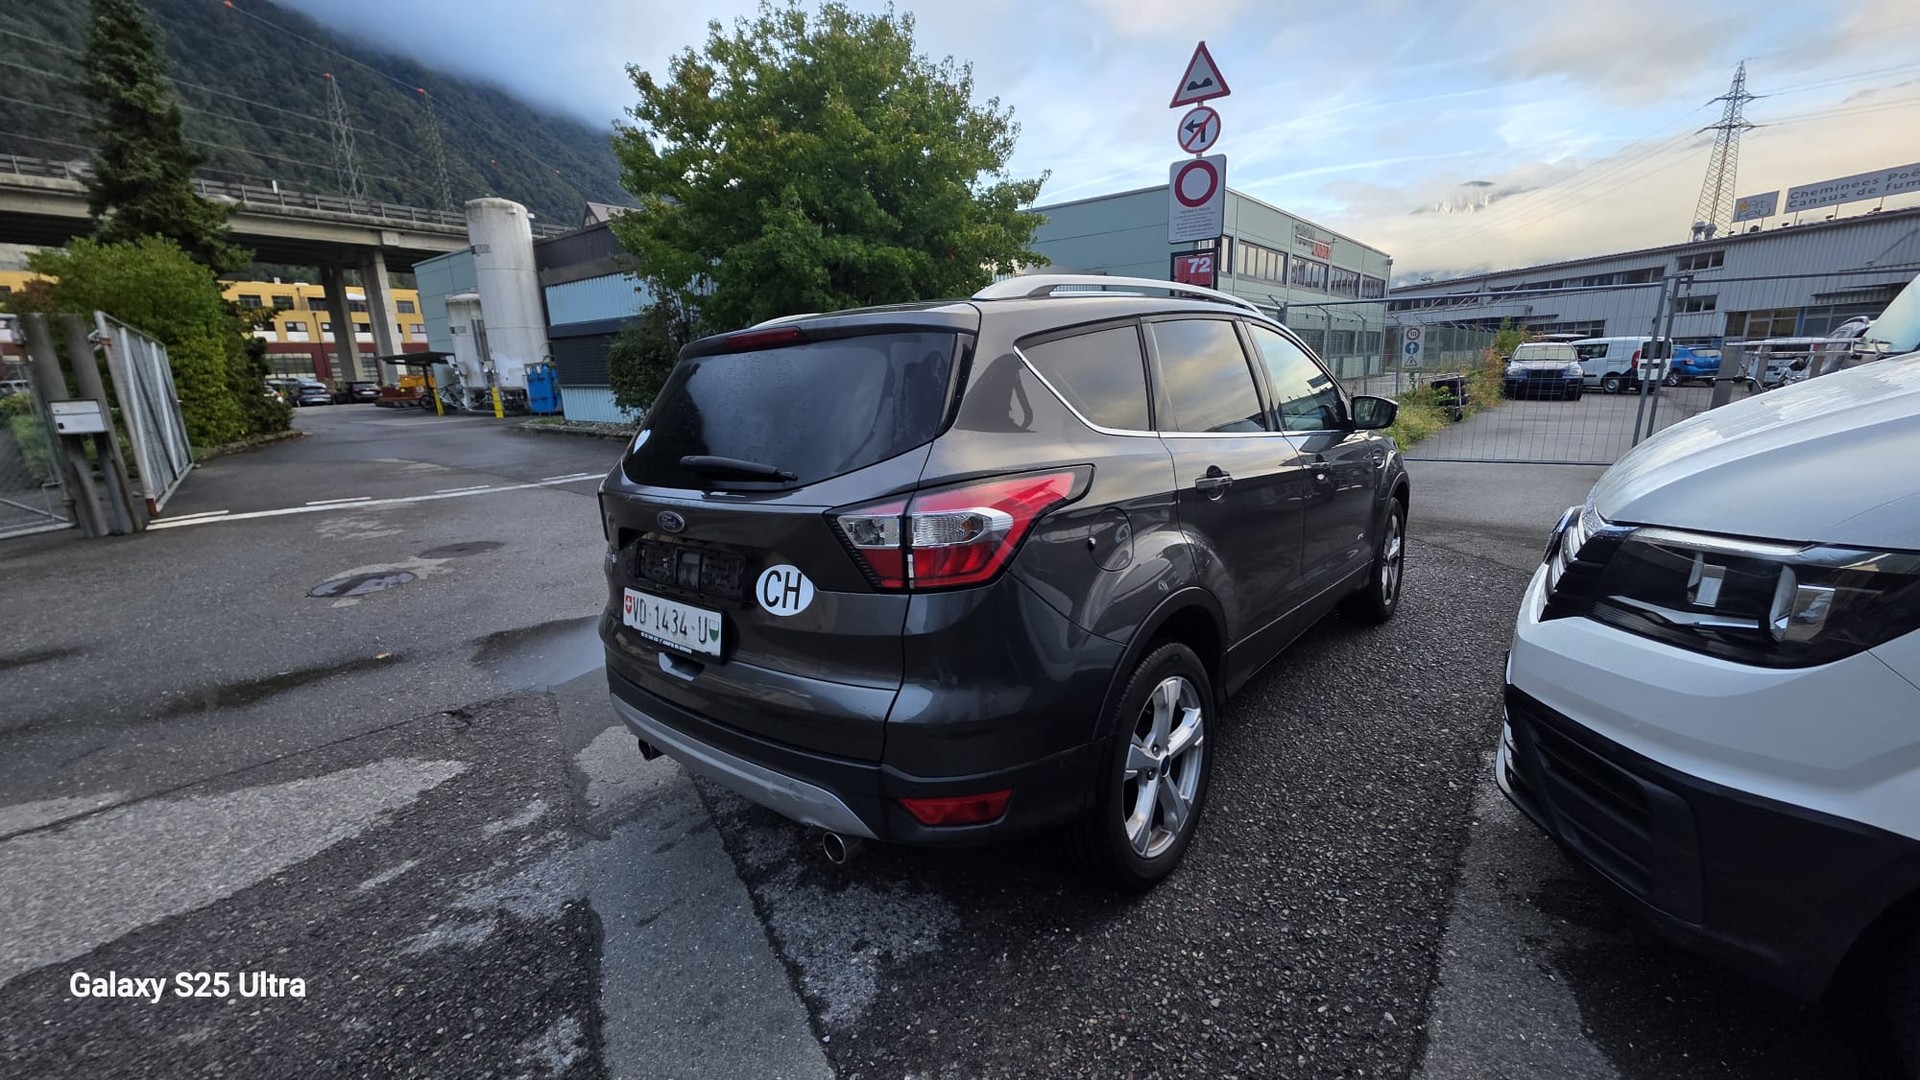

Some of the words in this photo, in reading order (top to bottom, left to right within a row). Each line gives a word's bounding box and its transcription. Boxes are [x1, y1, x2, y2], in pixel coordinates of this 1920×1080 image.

[1788, 192, 1848, 208] Canaux
[1856, 186, 1877, 196] de
[1789, 177, 1880, 200] Cheminées
[1187, 257, 1211, 274] 72
[763, 569, 803, 610] CH
